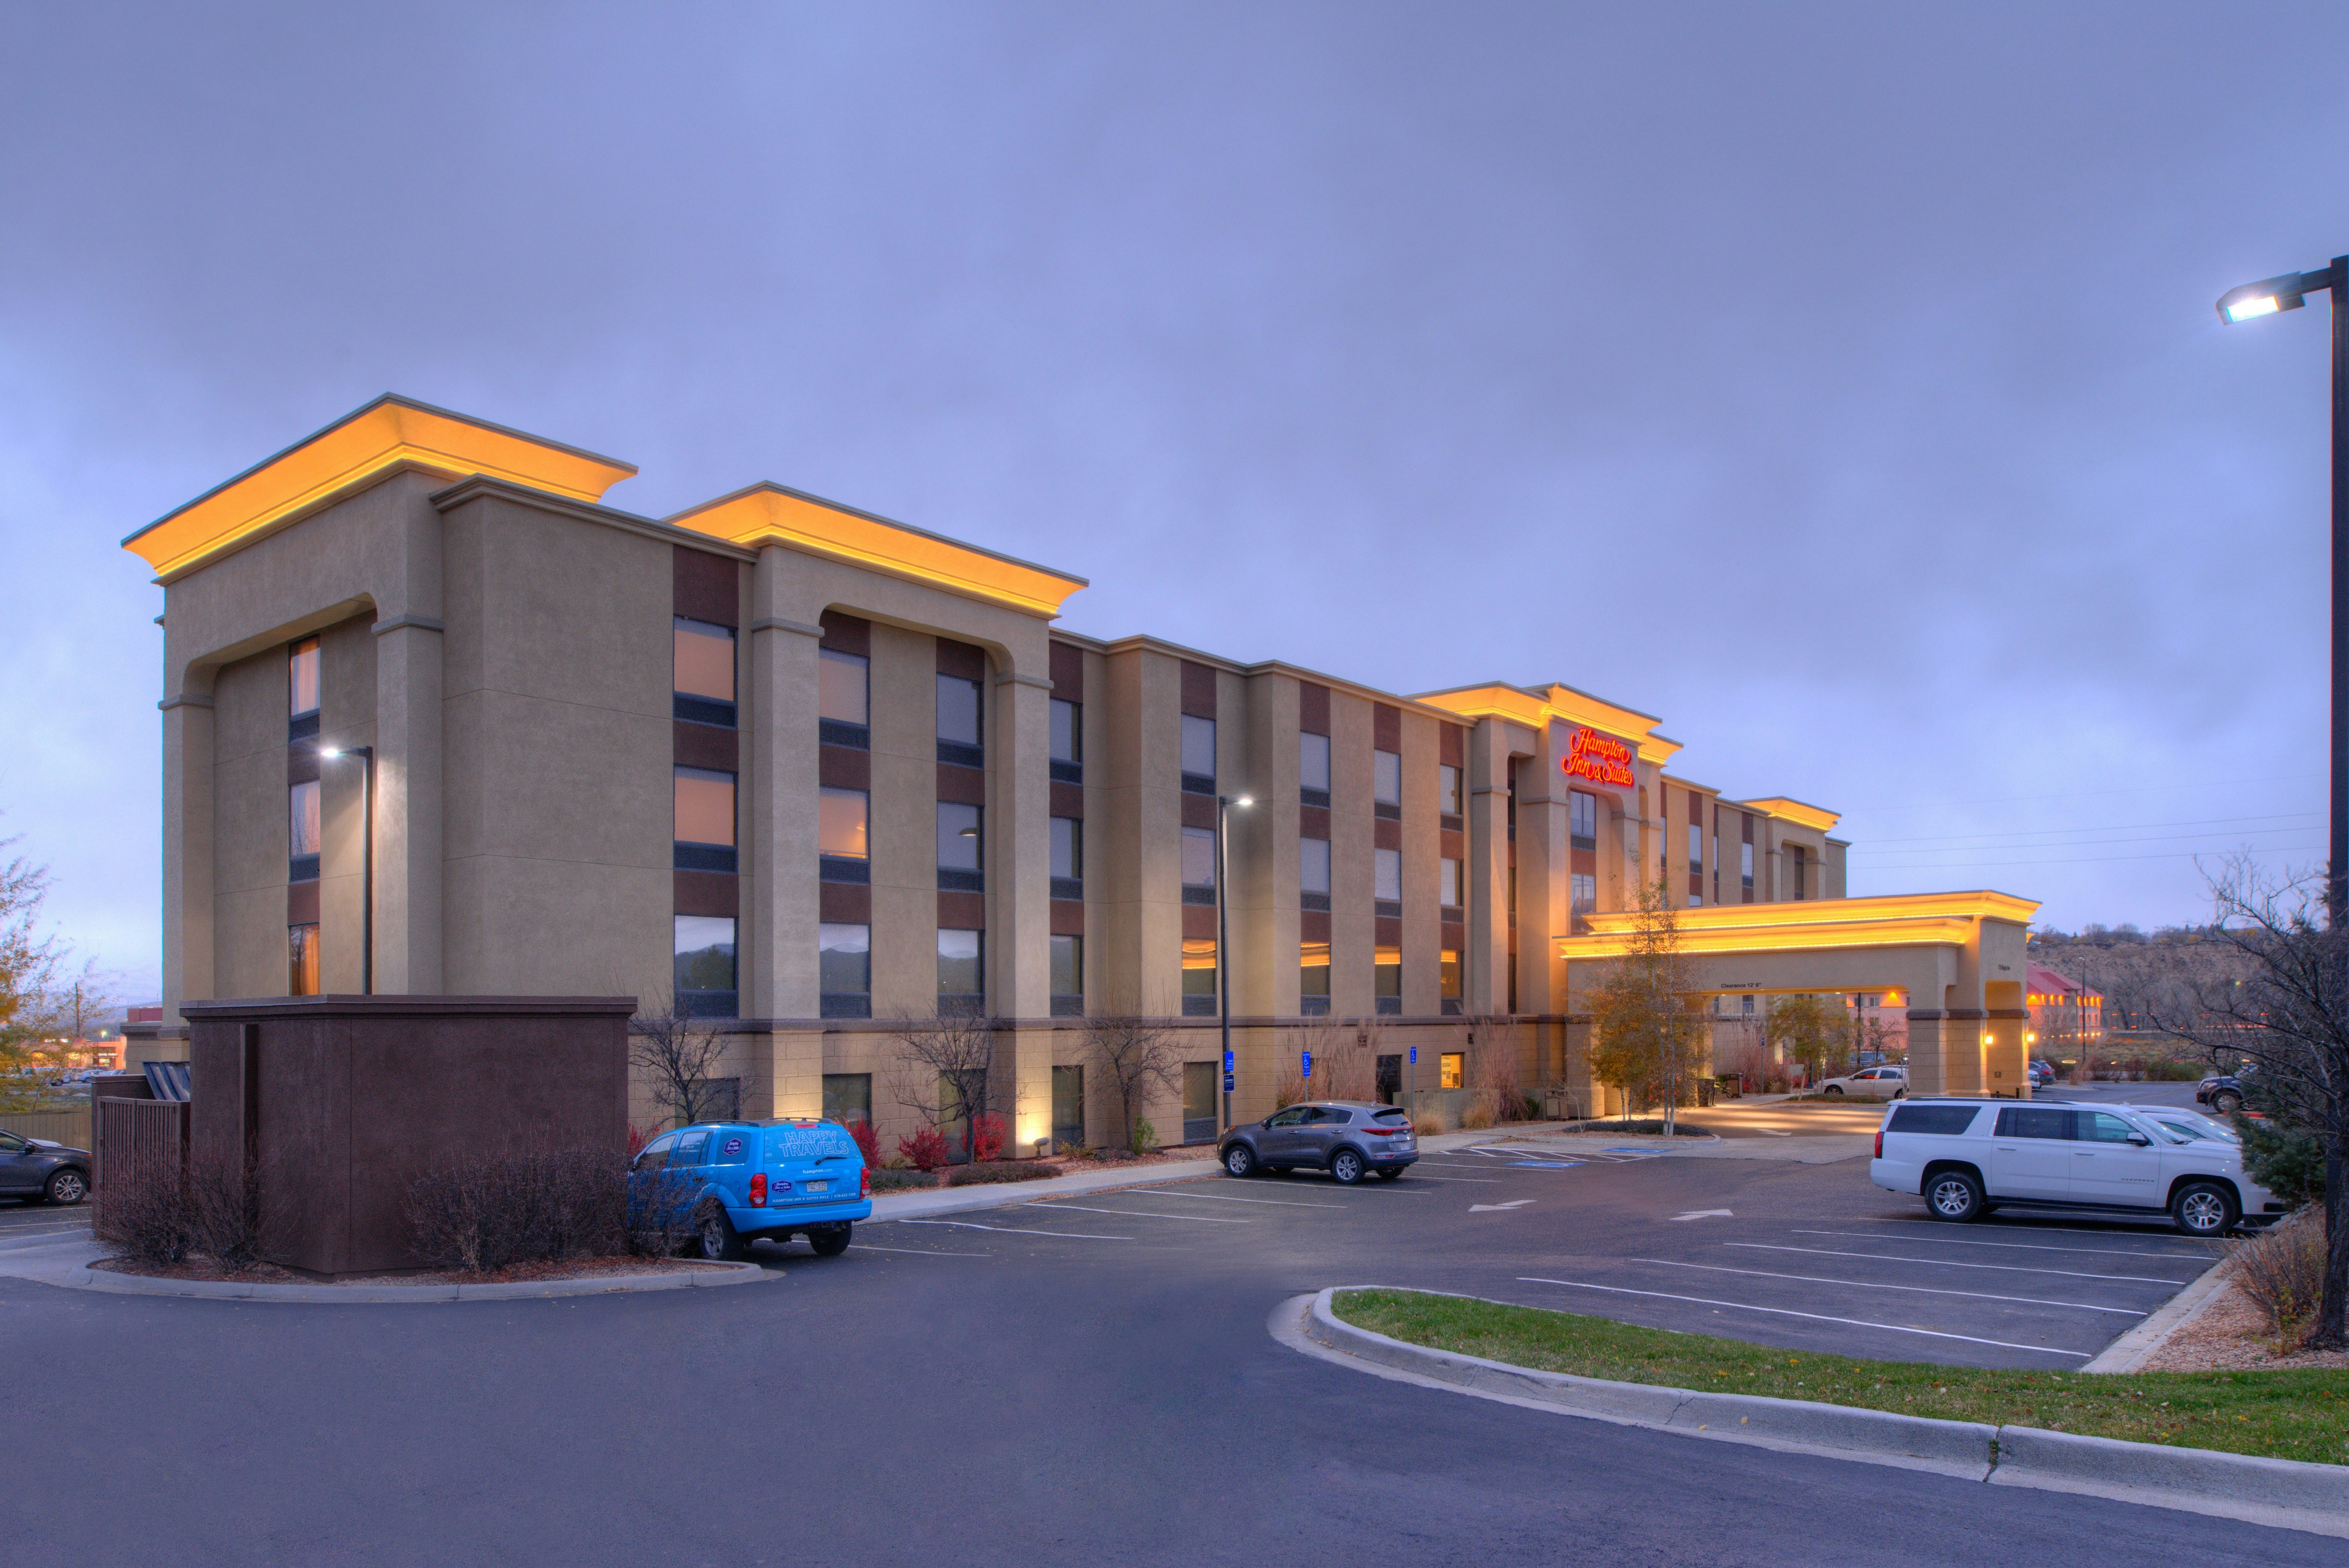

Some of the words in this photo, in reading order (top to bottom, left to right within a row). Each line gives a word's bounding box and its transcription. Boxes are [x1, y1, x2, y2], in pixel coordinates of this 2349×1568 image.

[1570, 728, 1631, 765] Hampton
[1561, 753, 1595, 780] Inn
[1594, 763, 1605, 783] &
[1602, 760, 1634, 787] Suites
[778, 1141, 849, 1157] TRAVELS
[785, 1131, 837, 1144] HAPPY
